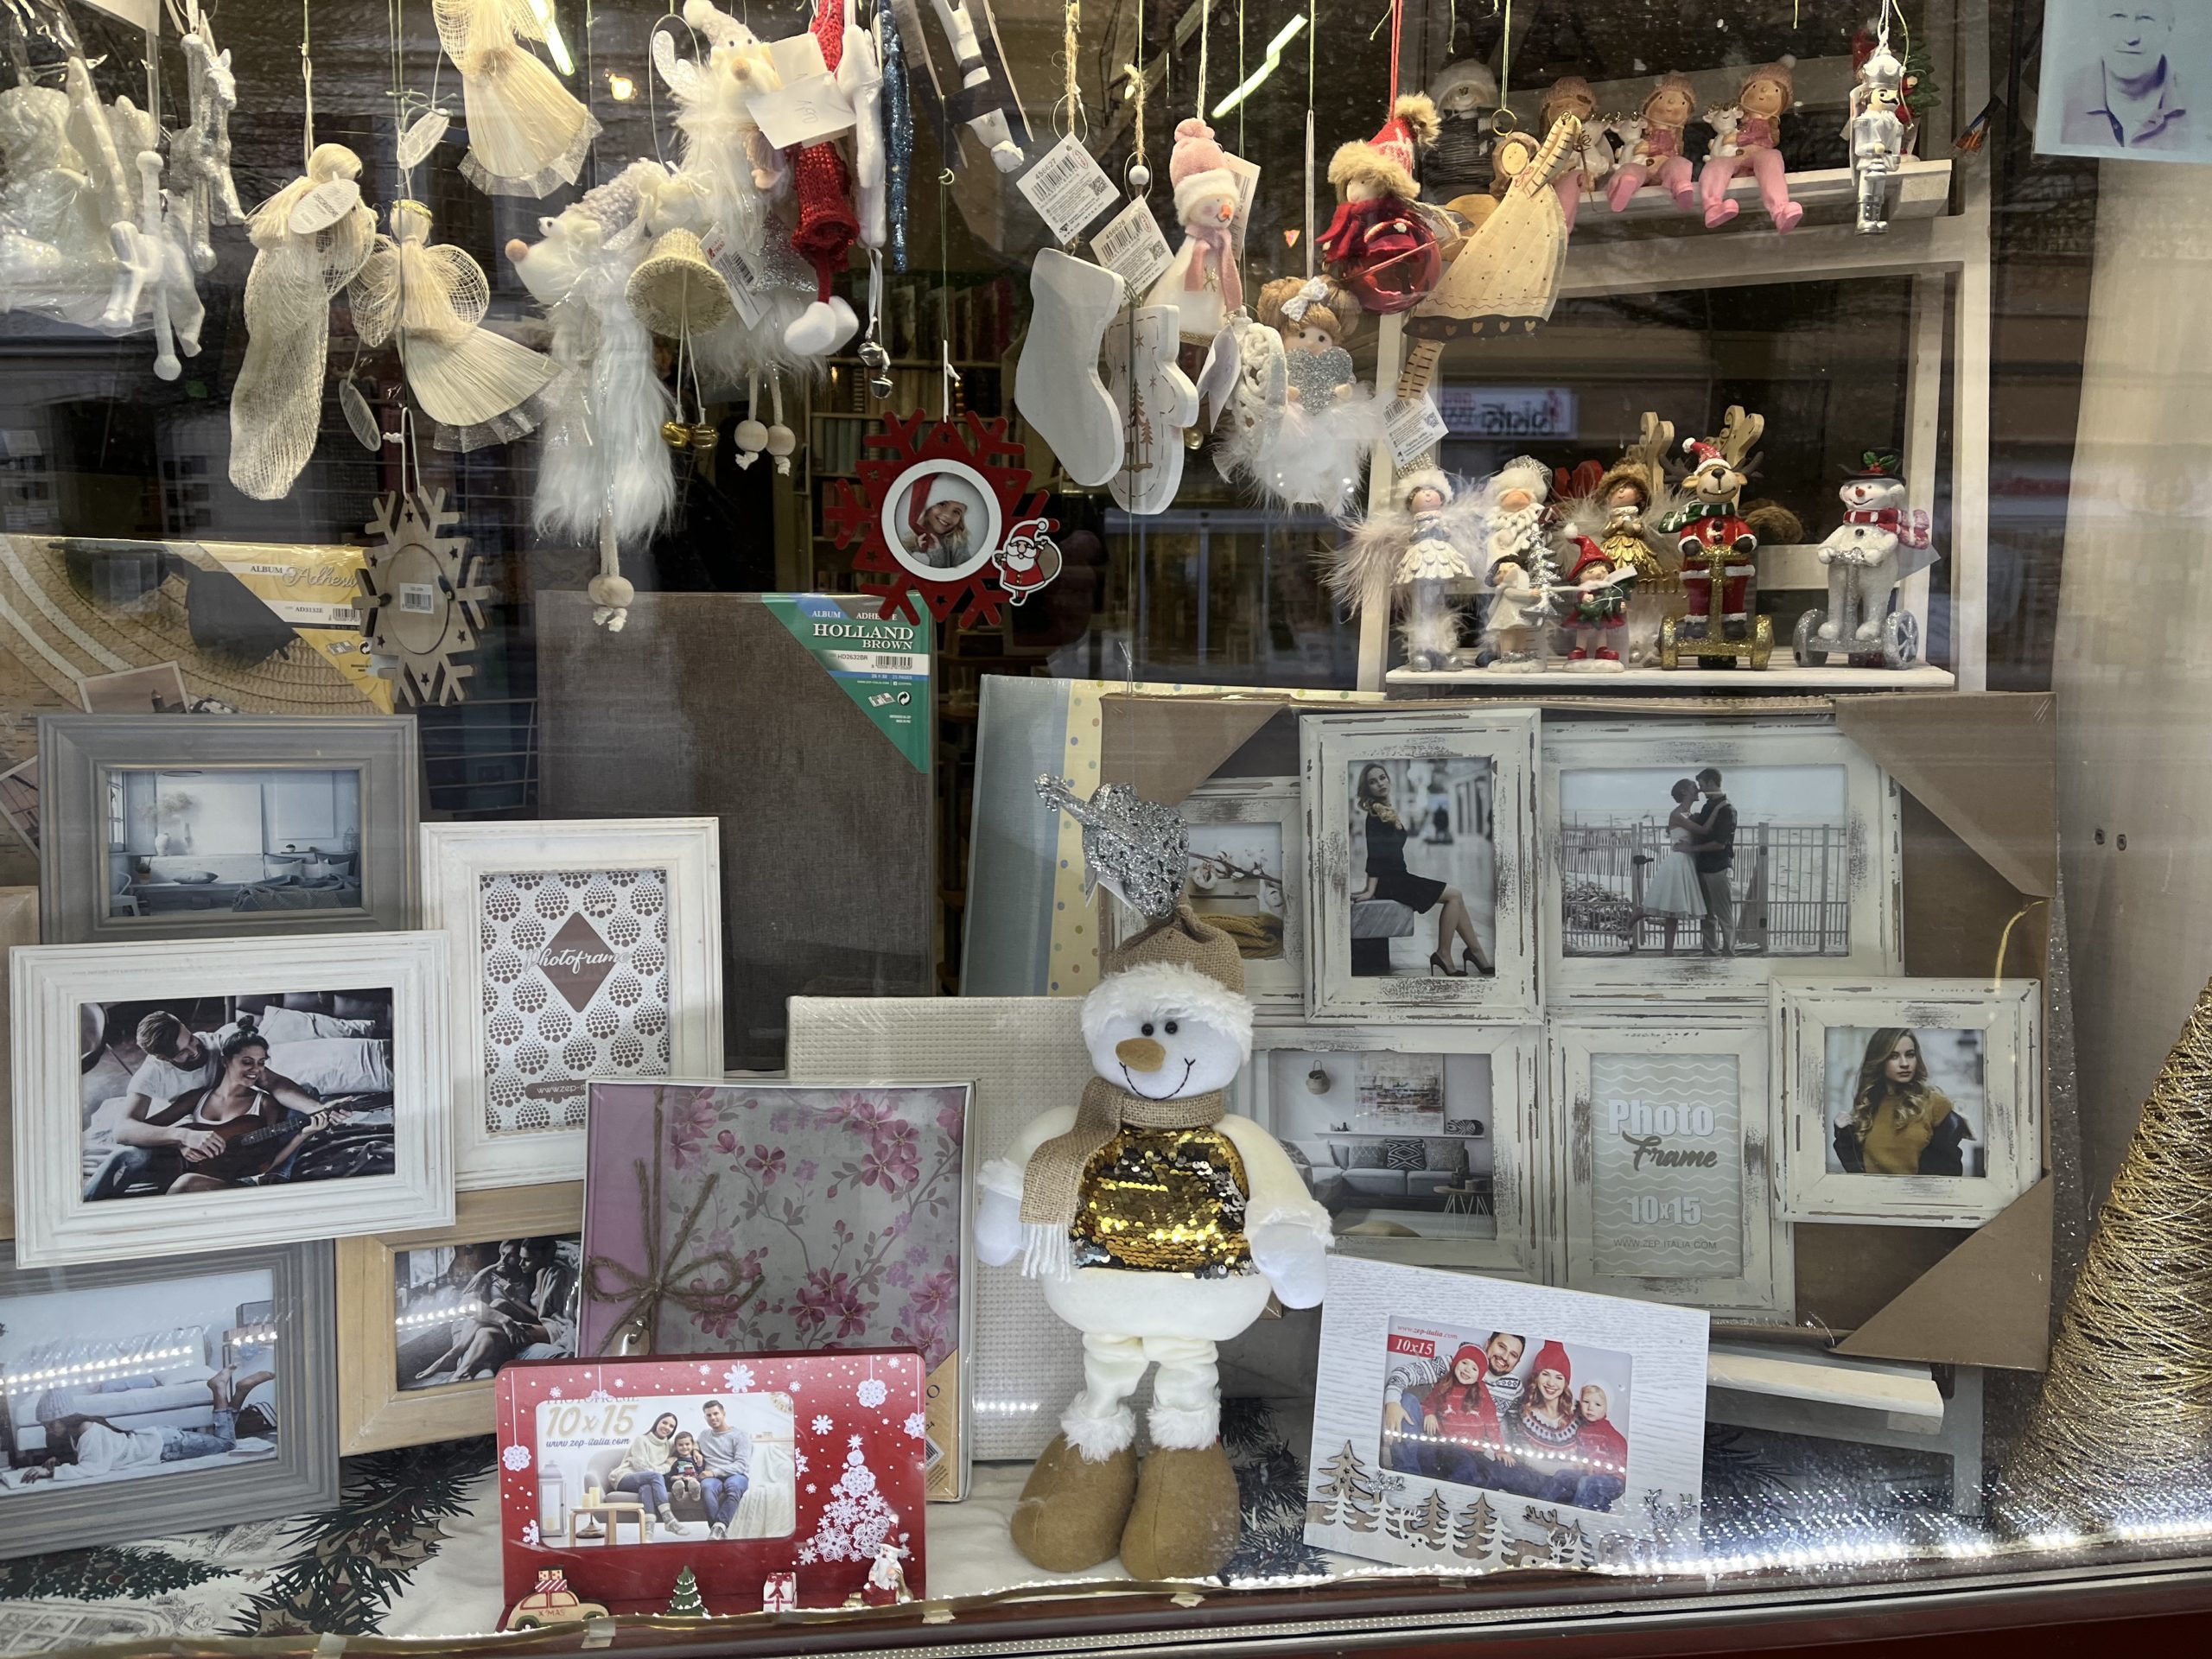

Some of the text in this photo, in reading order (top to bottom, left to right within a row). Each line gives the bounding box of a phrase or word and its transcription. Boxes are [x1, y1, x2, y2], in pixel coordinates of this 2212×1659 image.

[1035, 158, 1057, 180] 456627
[811, 610, 841, 619] ALBUM
[812, 623, 914, 640] HOLLAND
[862, 639, 913, 650] BROWN
[523, 947, 632, 974] Photoframe
[1608, 1099, 1715, 1136] Photo
[1622, 1130, 1718, 1172] Frame
[1627, 1195, 1702, 1225] 10x15
[1397, 1325, 1458, 1339] www.zep-italia.com
[1396, 1338, 1433, 1356] 10x15
[546, 1438, 630, 1448] www.zep-italia.com
